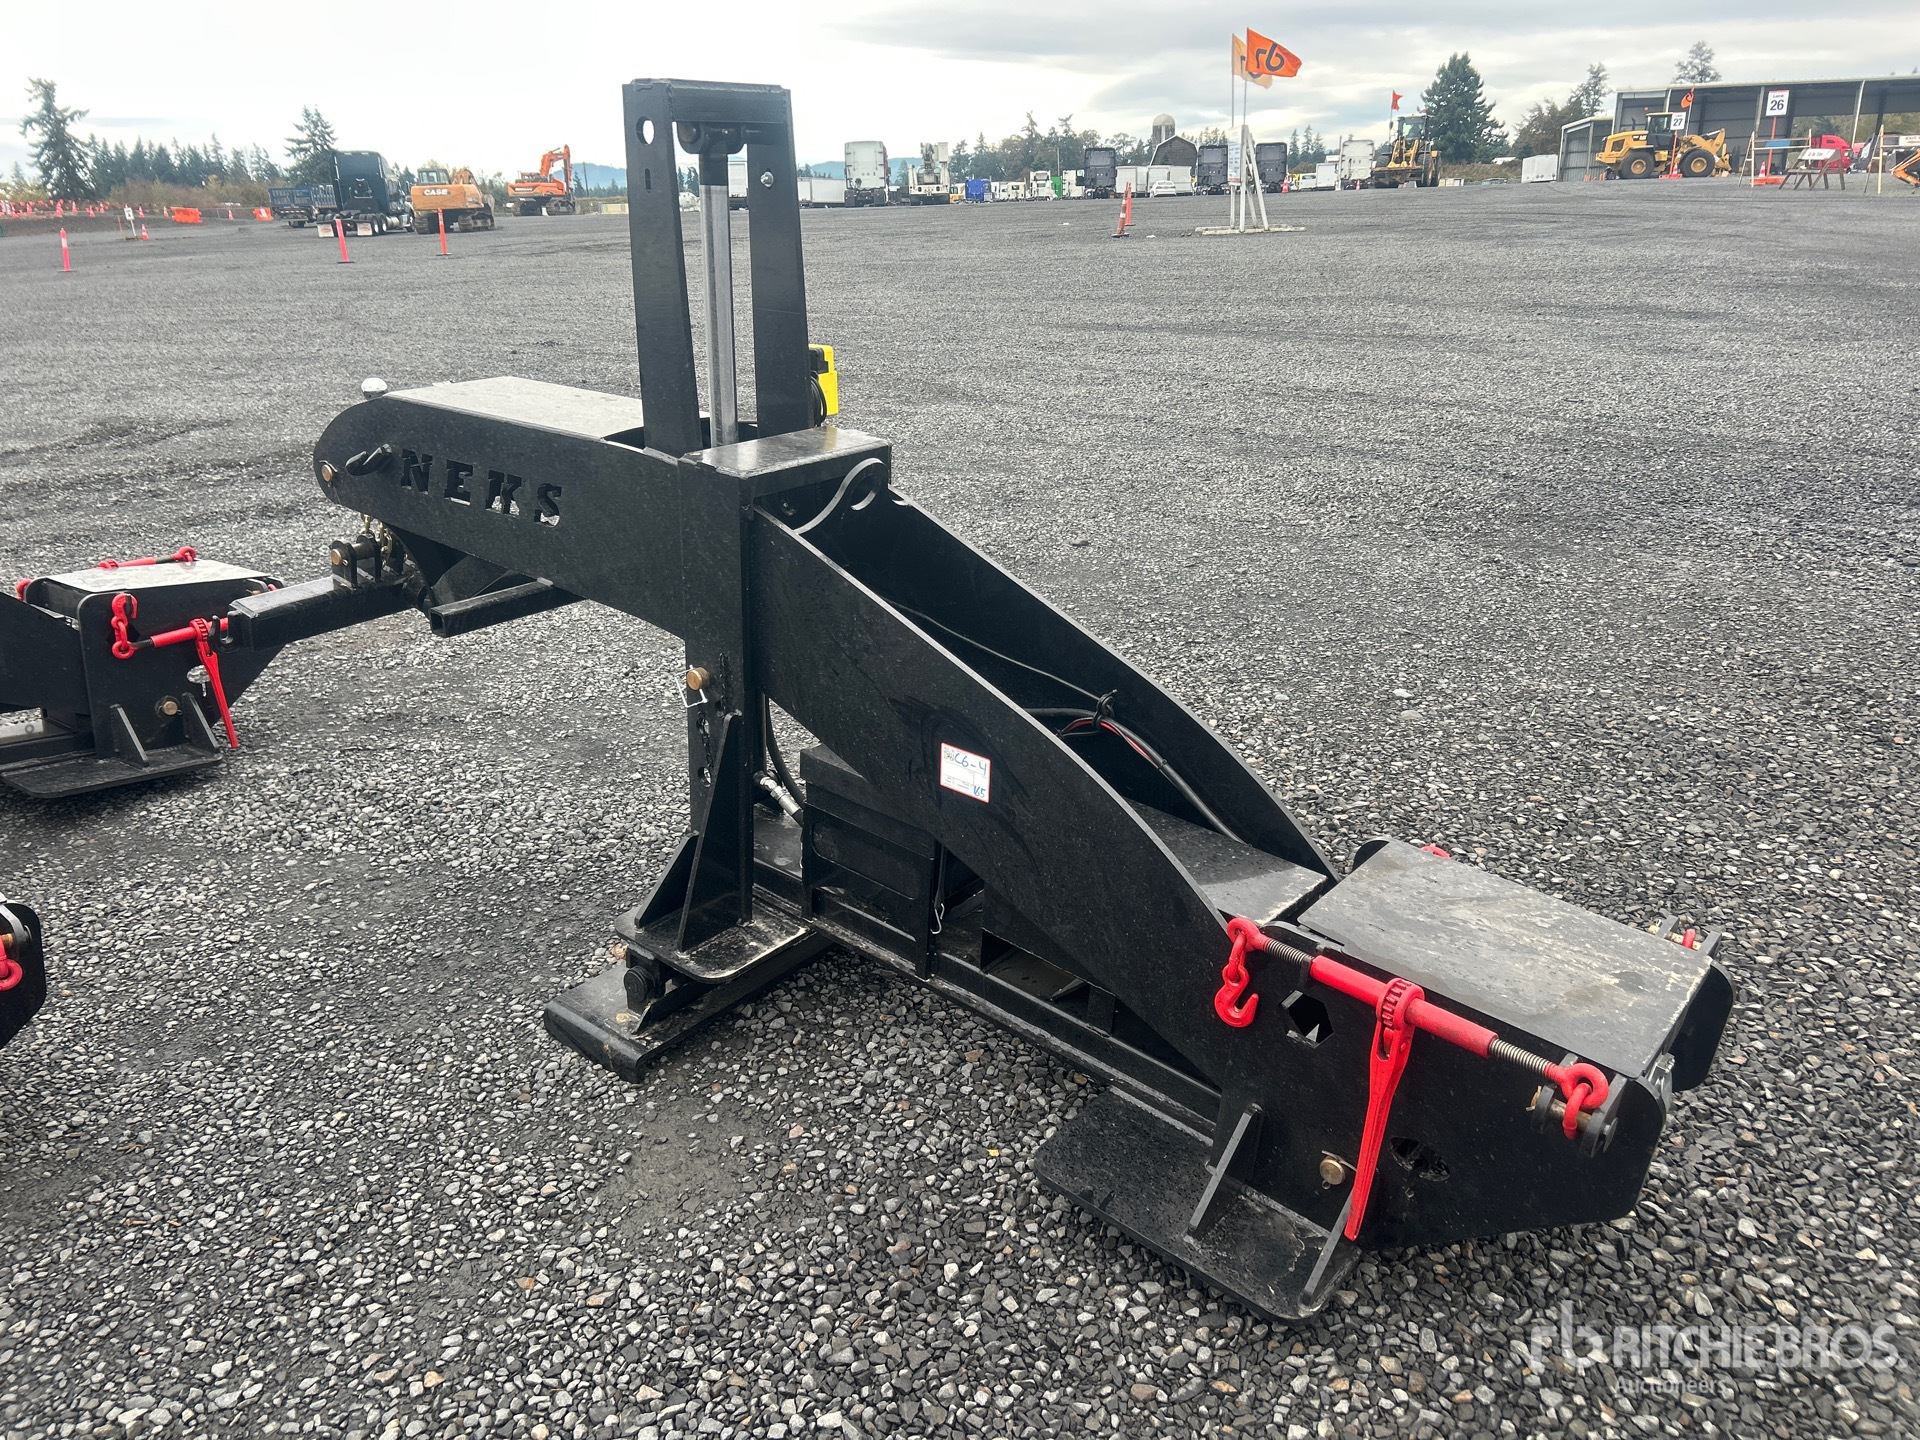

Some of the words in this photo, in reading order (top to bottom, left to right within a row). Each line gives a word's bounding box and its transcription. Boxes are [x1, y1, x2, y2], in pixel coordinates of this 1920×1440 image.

[1770, 99, 1785, 111] 26
[1673, 118, 1684, 127] 27
[423, 188, 449, 196] CASE
[401, 449, 563, 528] NEKS
[954, 752, 987, 776] C6-4
